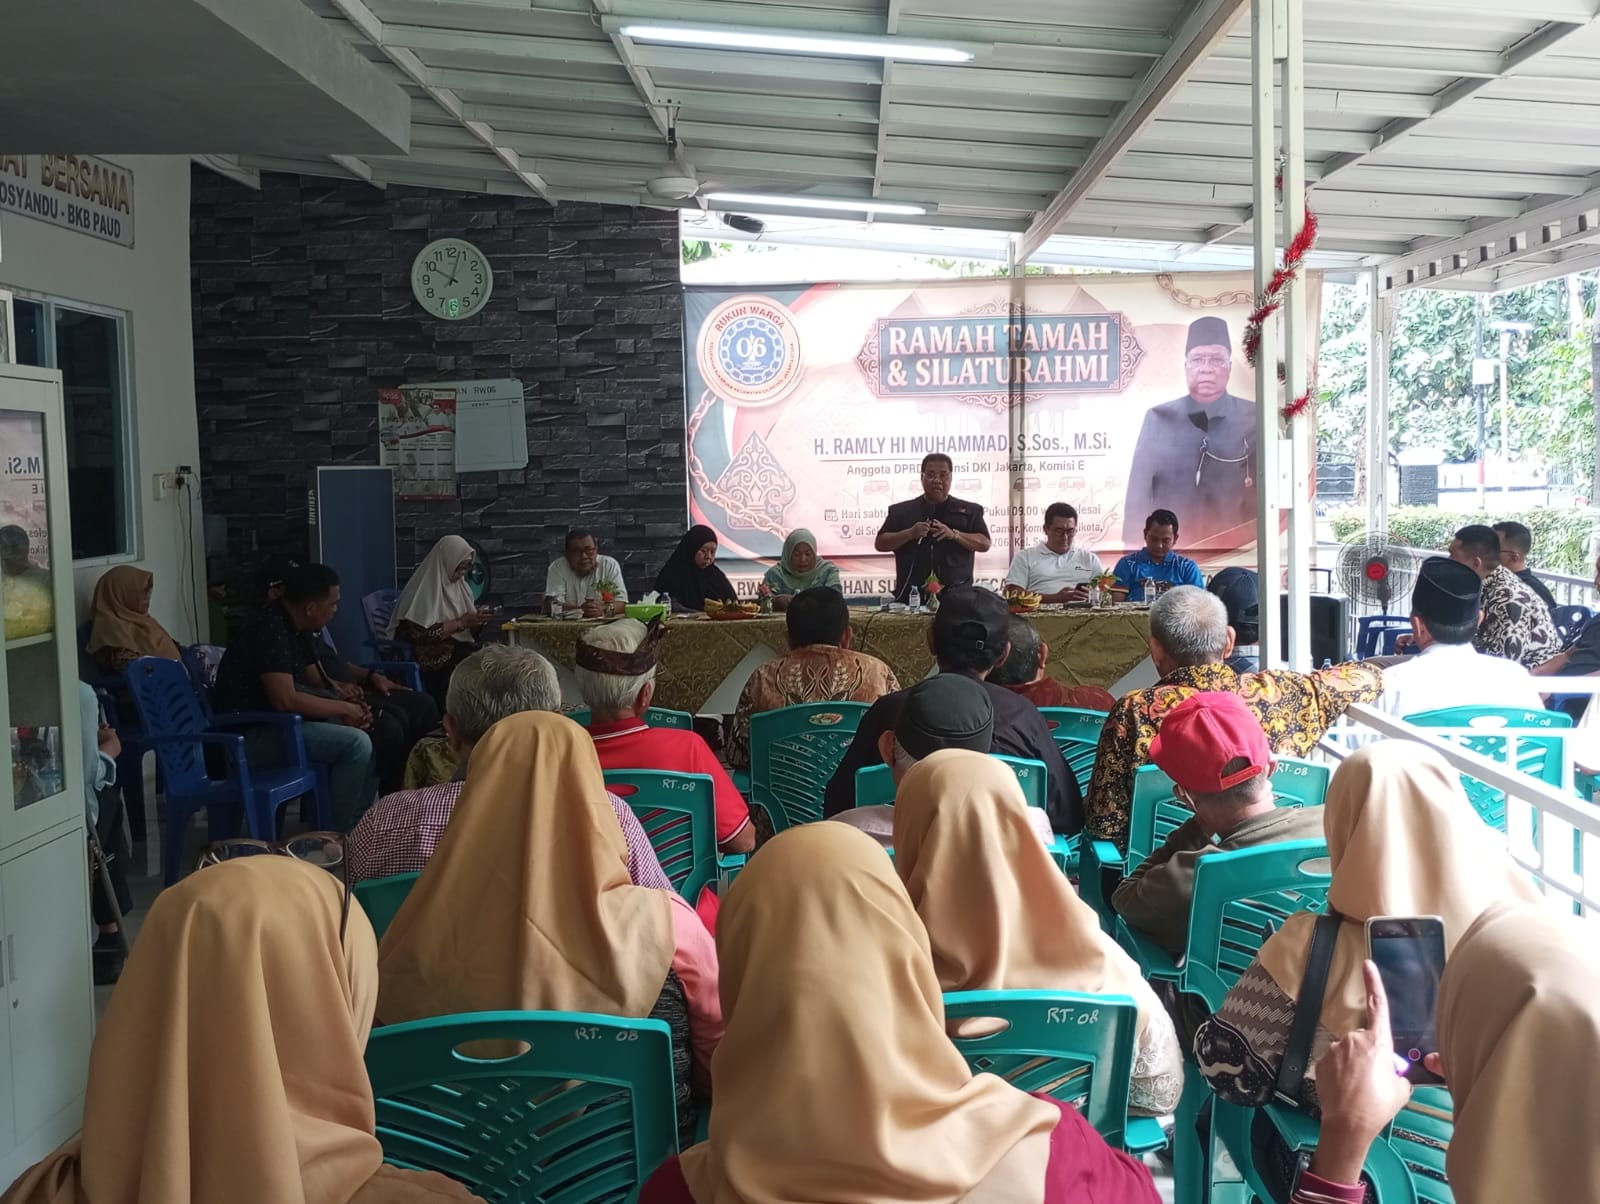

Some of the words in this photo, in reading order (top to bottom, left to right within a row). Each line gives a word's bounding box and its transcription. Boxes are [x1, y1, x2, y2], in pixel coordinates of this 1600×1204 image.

[41, 154, 130, 215] BERSAMA
[0, 181, 58, 219] OSYANDU
[68, 203, 91, 229] BKB
[93, 212, 121, 238] PAUD
[433, 251, 443, 261] 11
[445, 247, 457, 258] 12
[462, 251, 467, 261] 1
[425, 261, 437, 272] 10
[470, 260, 478, 271] 2
[422, 274, 430, 285] 9
[474, 273, 483, 284] 3
[427, 287, 434, 298] 8
[471, 287, 479, 297] 4
[438, 297, 446, 308] 7
[450, 300, 458, 311] 6
[463, 297, 470, 307] 5
[714, 306, 747, 332] RUKUN
[749, 306, 785, 329] WARGA
[888, 325, 996, 355] RAMAH
[1003, 321, 1109, 352] TAMAH
[736, 337, 767, 358] 06
[887, 358, 908, 387] &
[915, 353, 1109, 387] SILATURAHMI
[814, 437, 829, 455] H.
[833, 436, 886, 455] RAMLY
[890, 436, 905, 453] HI
[910, 434, 1013, 454] MUHAMMAD,
[1074, 432, 1112, 450] M.Si.
[846, 464, 891, 477] Anggota
[972, 462, 991, 473] DKI
[994, 461, 1037, 473] Jakarta,
[1039, 460, 1075, 472] Komisi
[1078, 460, 1085, 471] E
[841, 508, 861, 519] Hari
[1011, 505, 1039, 516] 09.00
[1075, 503, 1101, 515] lesai
